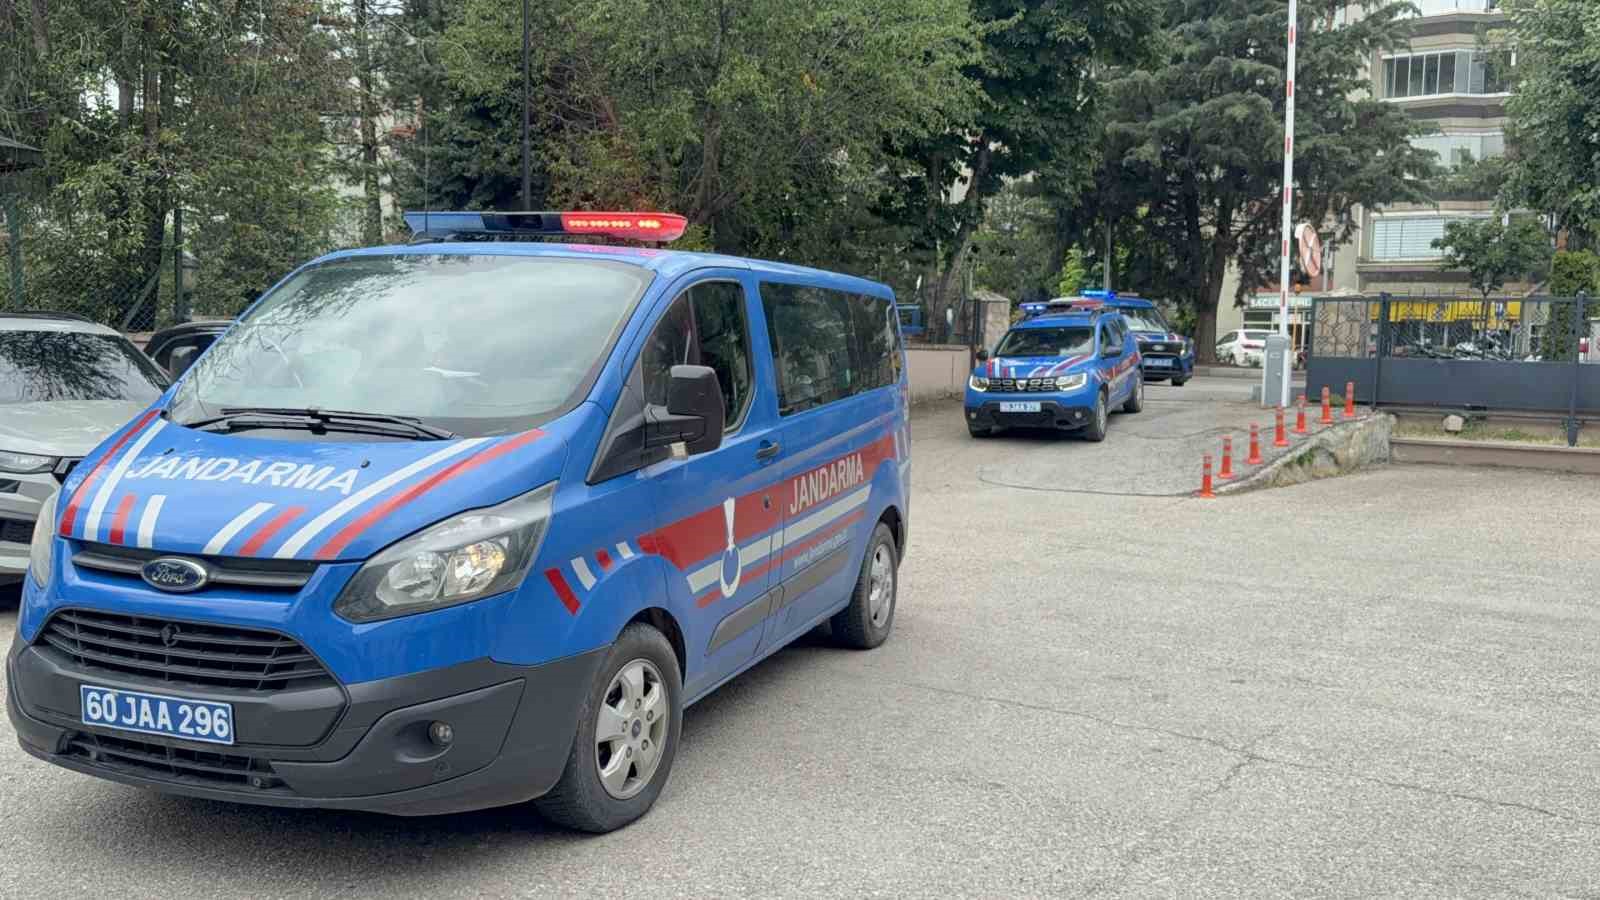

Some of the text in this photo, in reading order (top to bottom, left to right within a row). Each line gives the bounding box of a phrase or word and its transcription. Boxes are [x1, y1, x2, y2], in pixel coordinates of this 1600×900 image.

[125, 456, 360, 495] JANDARMA
[790, 453, 864, 514] JANDARMA
[150, 562, 192, 585] Ford
[86, 691, 230, 738] 60 JAA 296
